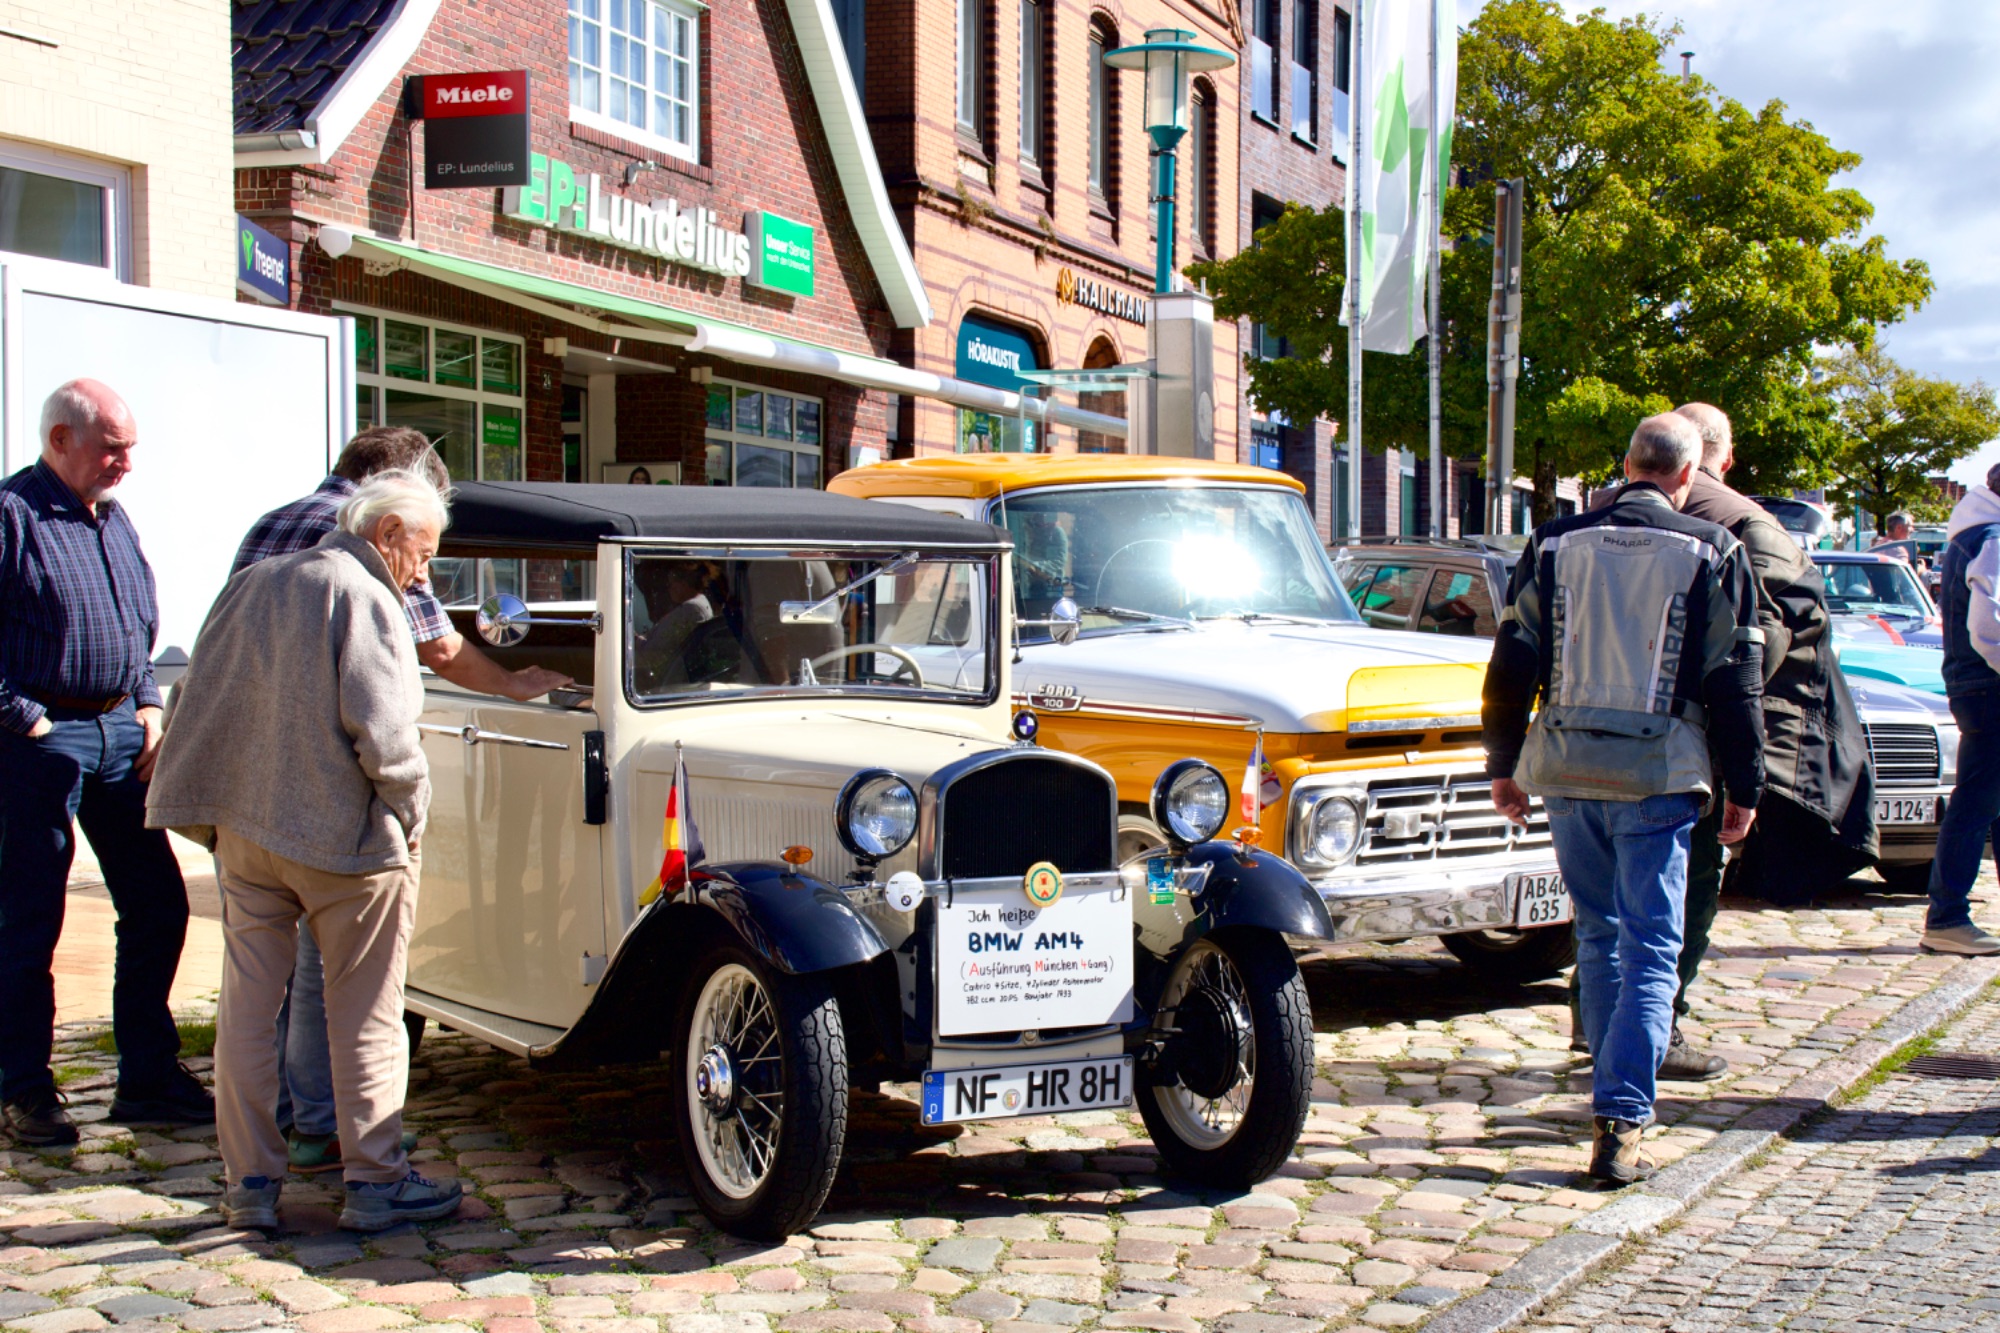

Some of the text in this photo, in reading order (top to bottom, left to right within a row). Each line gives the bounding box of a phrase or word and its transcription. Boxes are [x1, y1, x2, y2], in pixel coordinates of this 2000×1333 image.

[436, 85, 513, 104] Miele
[437, 161, 514, 175] EP: Lundelius
[588, 172, 750, 277] Lundelius
[788, 240, 811, 260] Service
[255, 241, 285, 287] freenet
[1077, 277, 1146, 324] HALLMAN
[968, 337, 1020, 371] HÖRAKUSTIK
[1038, 684, 1076, 697] FORD
[1043, 698, 1064, 708] 100
[1894, 800, 1923, 820] 124
[998, 908, 1036, 925] heiße
[1529, 899, 1559, 922] 635
[968, 932, 1084, 953] BMW AM4
[1035, 958, 1078, 972] München
[963, 982, 991, 992] Cabrio
[1024, 991, 1053, 1001] Baujahr
[956, 1064, 1121, 1115] NF HR 8H
[930, 1103, 938, 1114] D
